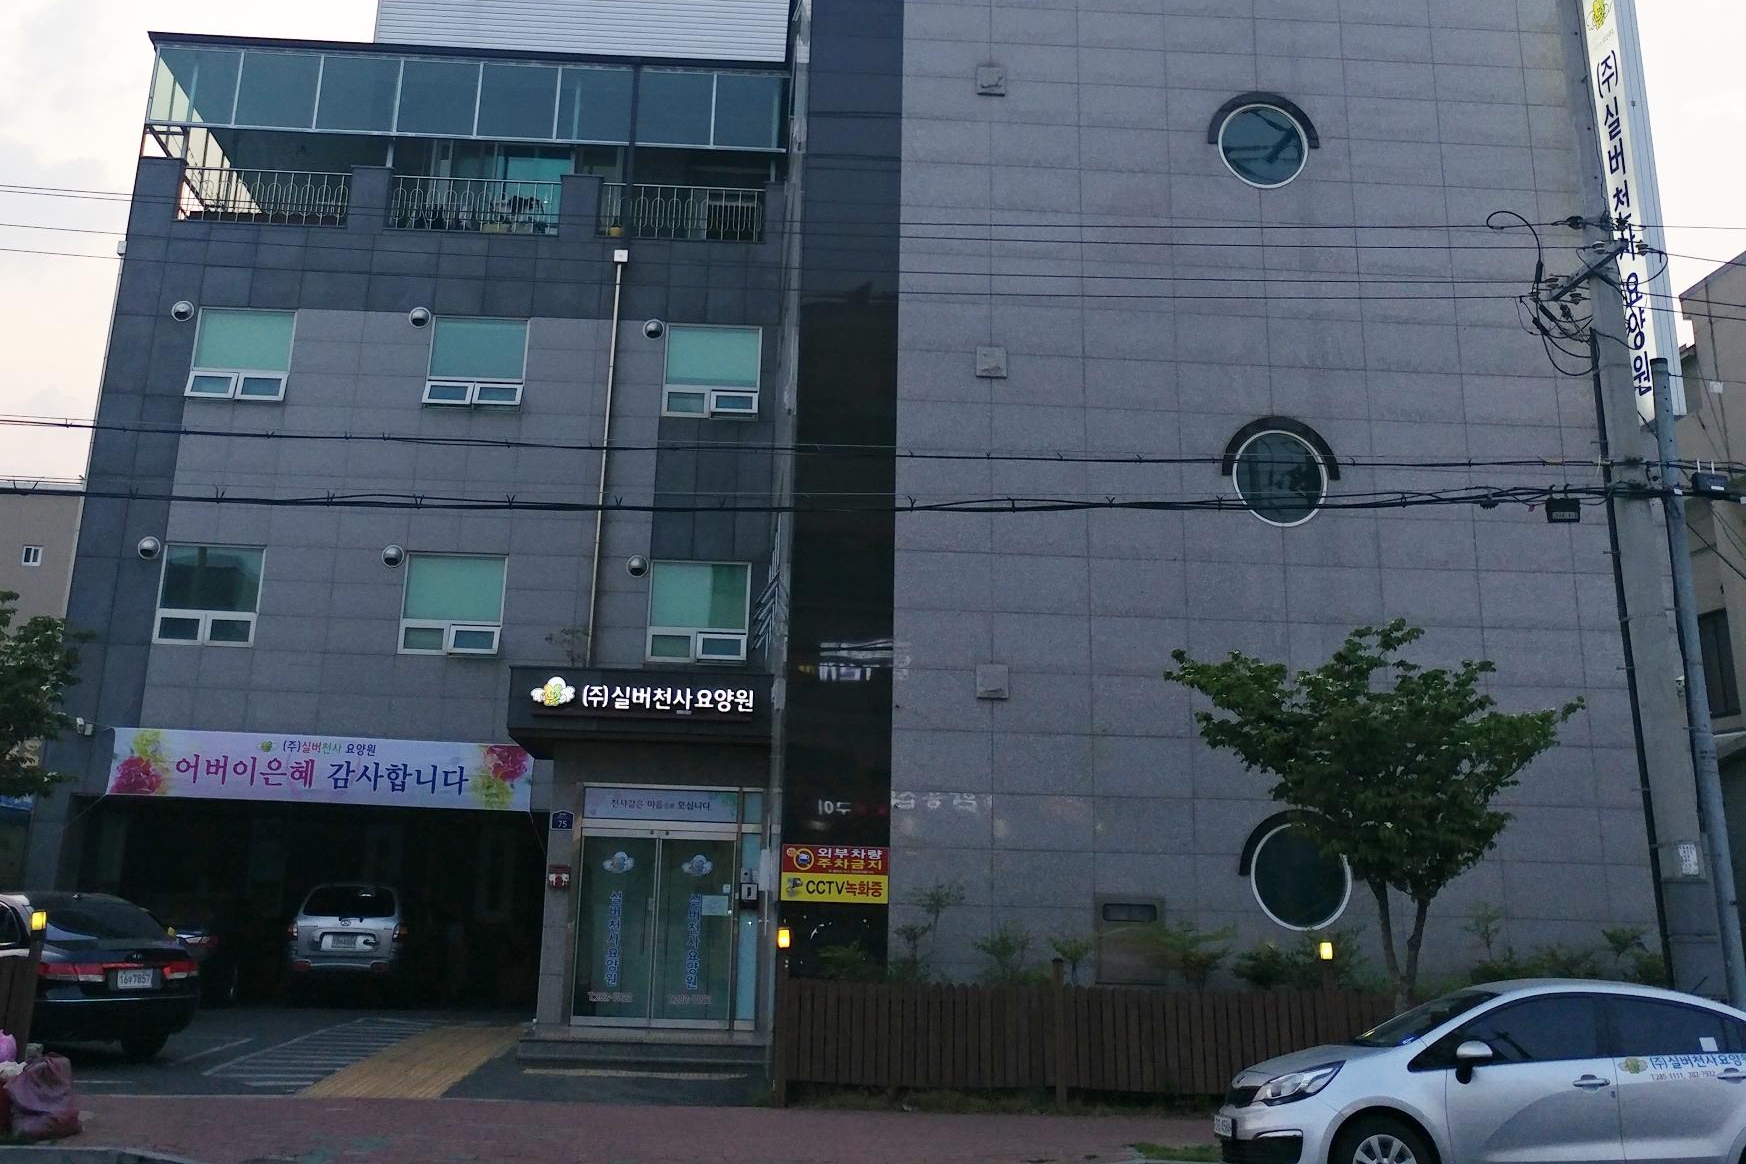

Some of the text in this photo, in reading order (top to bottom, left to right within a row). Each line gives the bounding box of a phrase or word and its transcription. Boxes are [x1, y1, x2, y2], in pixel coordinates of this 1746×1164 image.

[175, 754, 469, 795] 어버이은혜 감사합니다
[557, 820, 568, 829] 75
[817, 847, 882, 860] 외부차량
[816, 858, 882, 870] 주차금지
